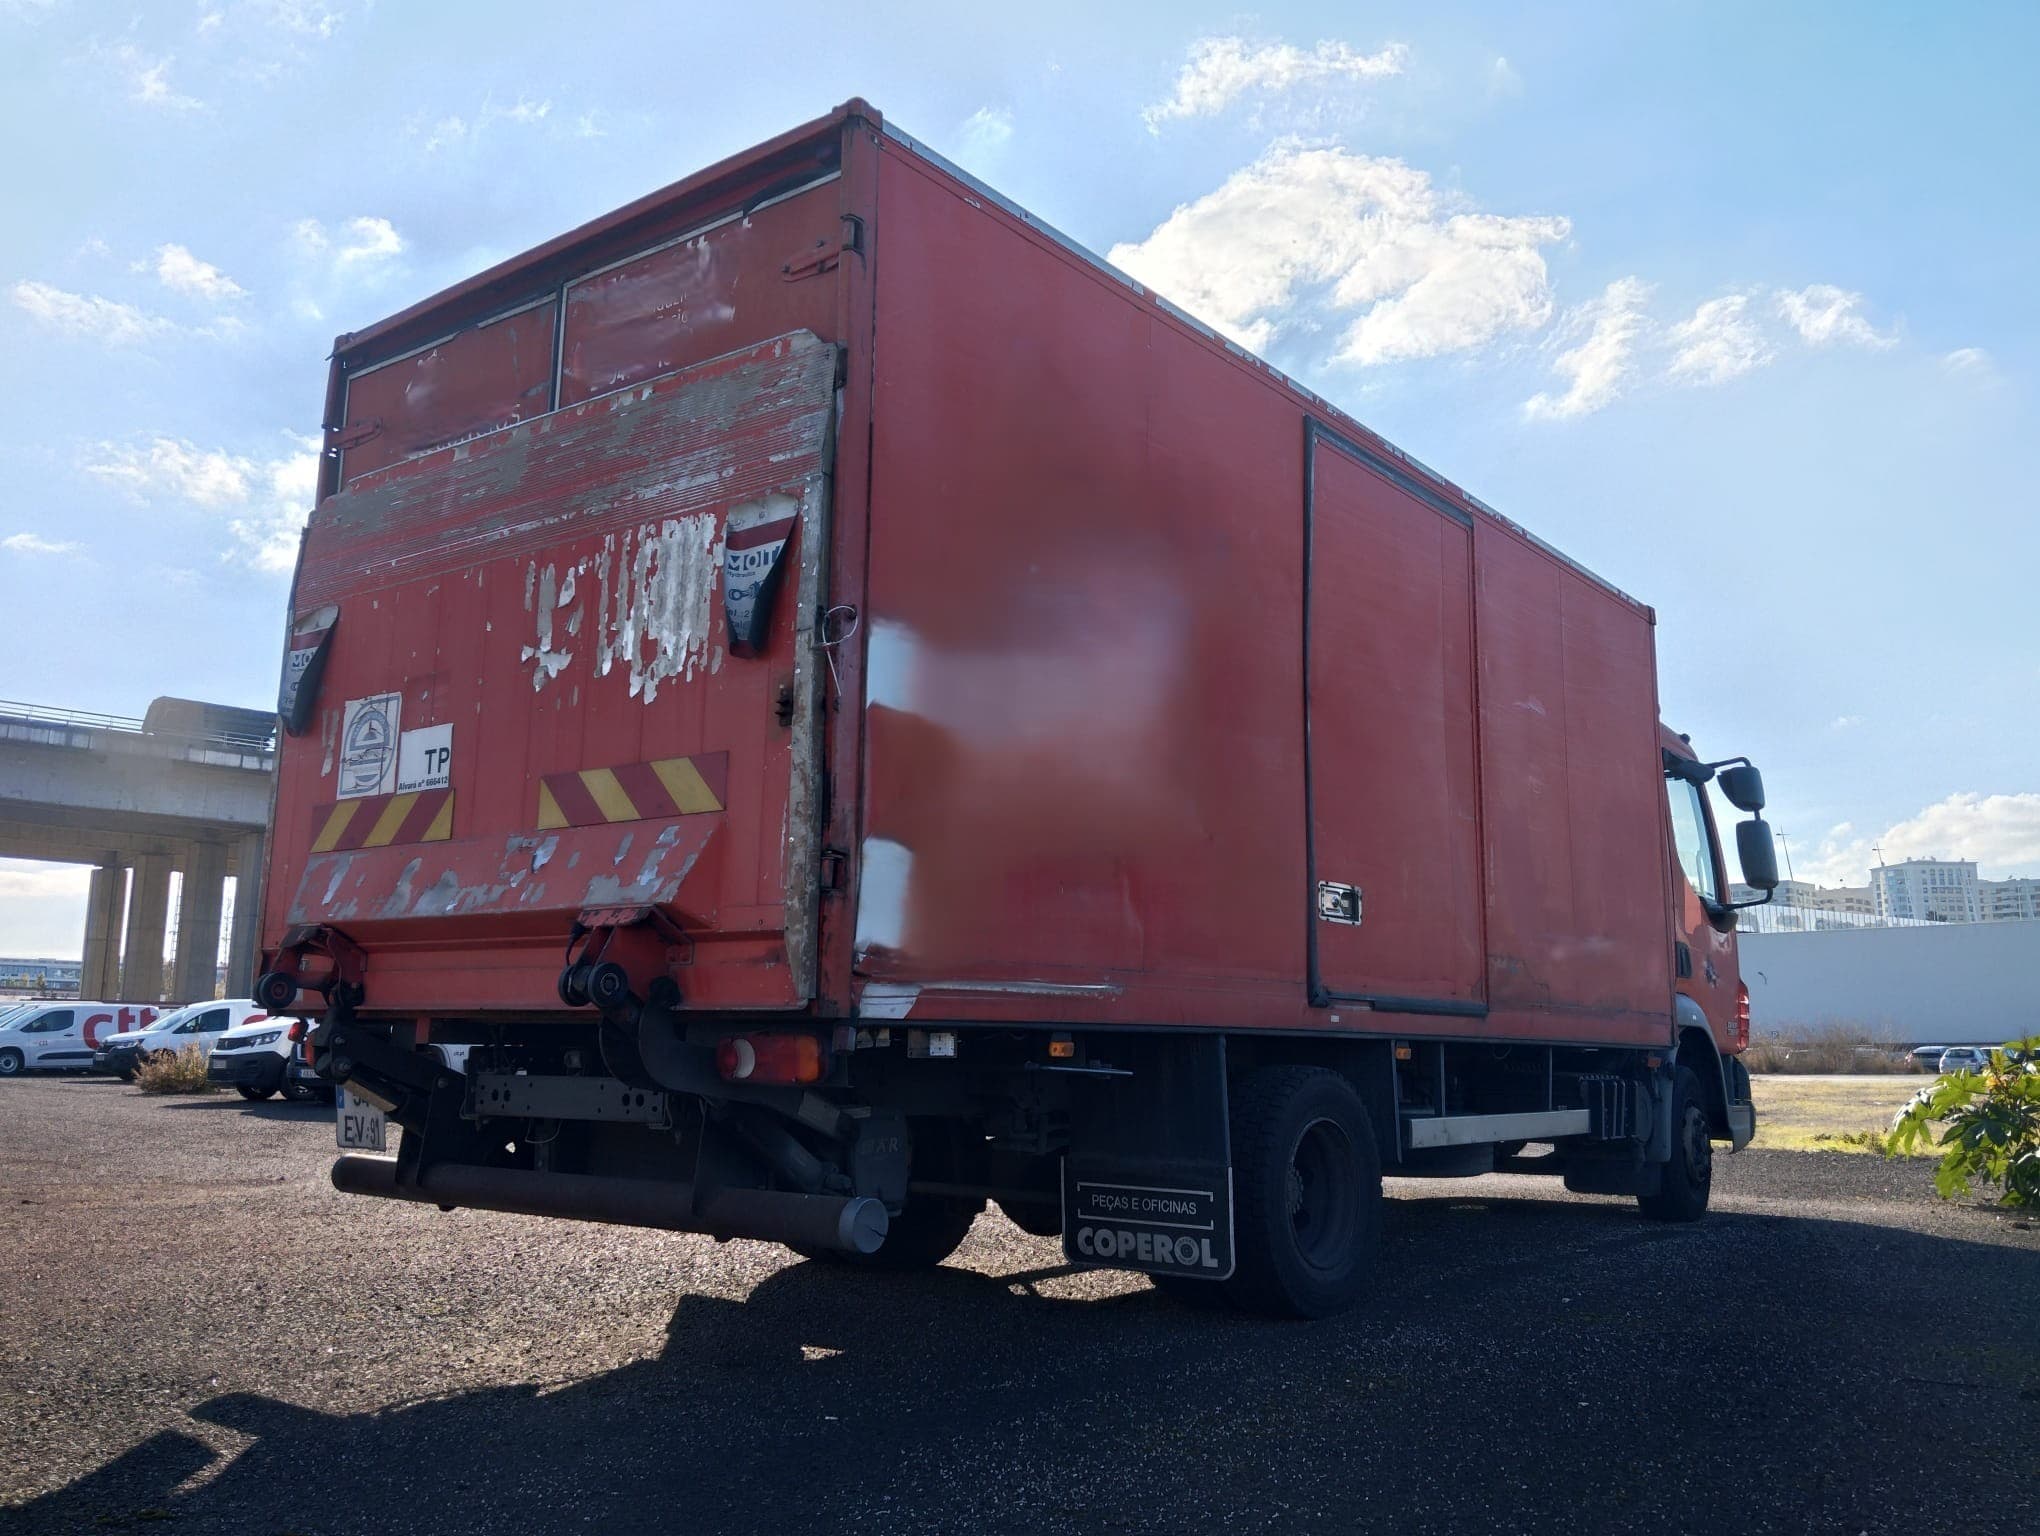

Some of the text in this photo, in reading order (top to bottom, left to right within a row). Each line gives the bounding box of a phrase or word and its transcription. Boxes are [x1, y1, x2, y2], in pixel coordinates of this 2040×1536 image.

[425, 747, 450, 774] TP
[1091, 1194, 1197, 1215] PEÇAS E OFICINAS
[1077, 1226, 1219, 1268] COPEROL
